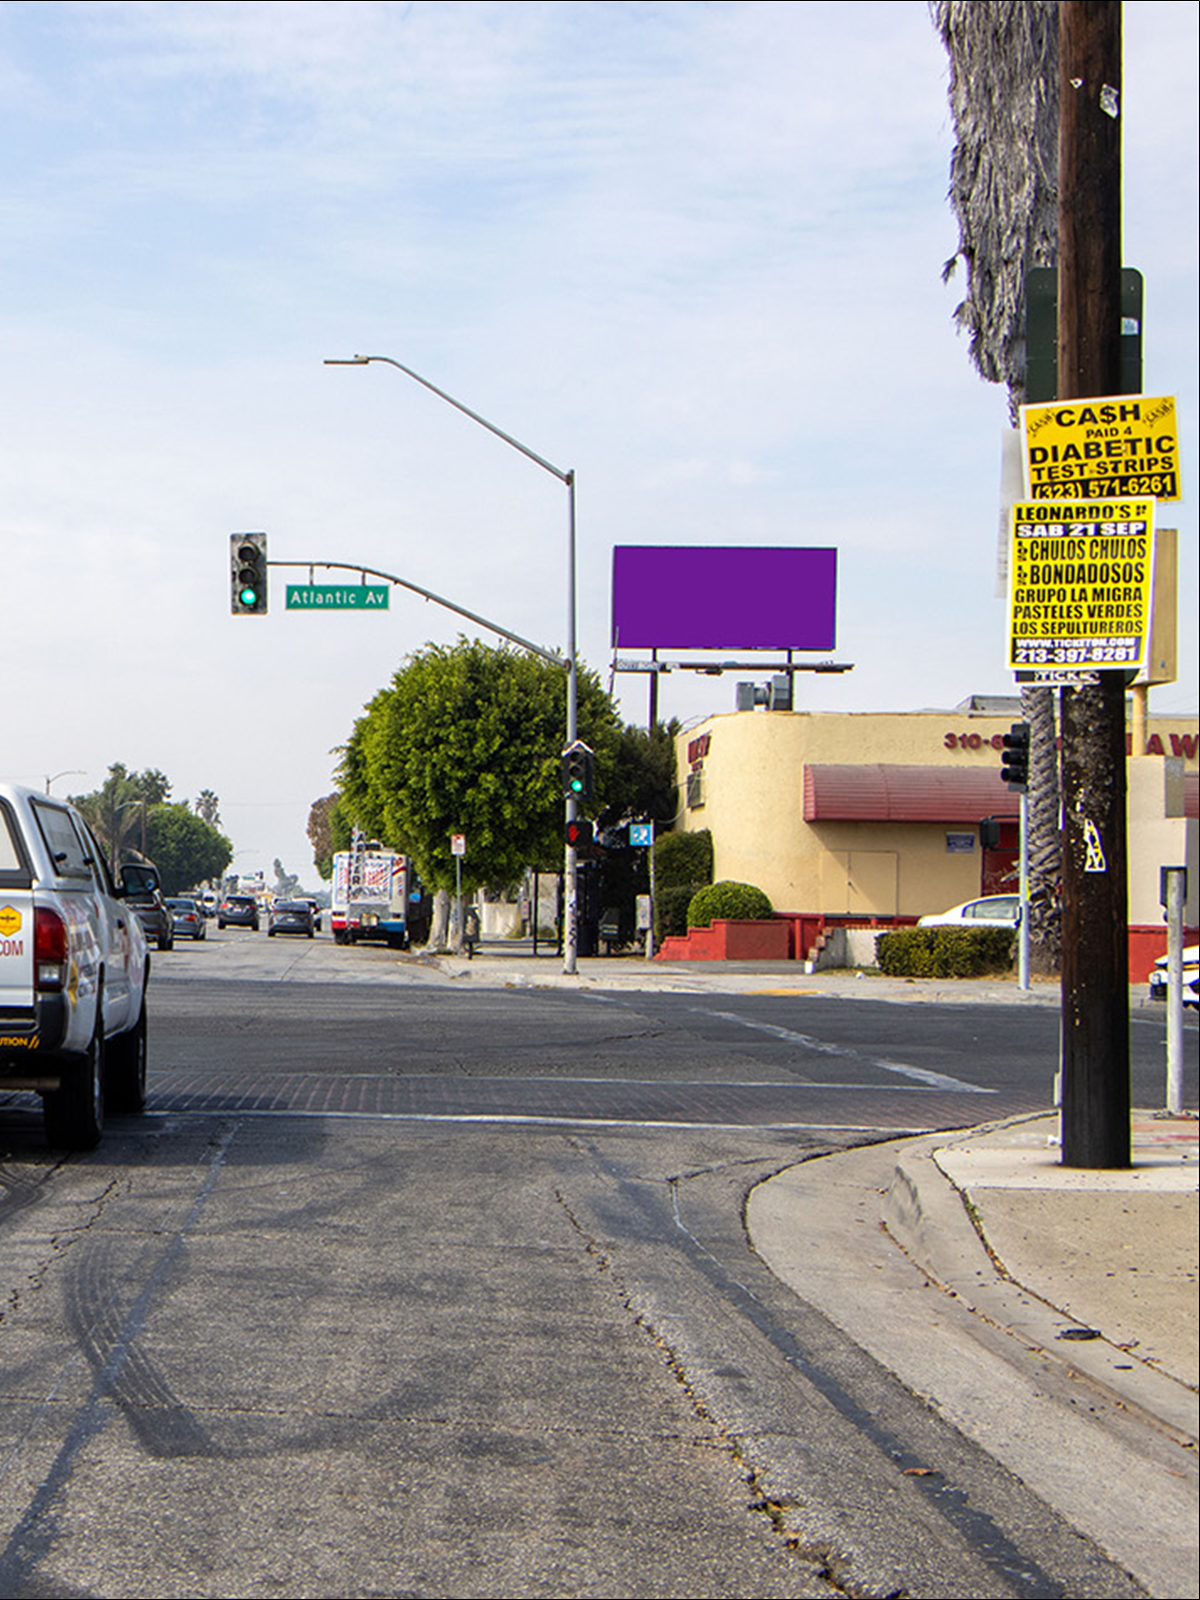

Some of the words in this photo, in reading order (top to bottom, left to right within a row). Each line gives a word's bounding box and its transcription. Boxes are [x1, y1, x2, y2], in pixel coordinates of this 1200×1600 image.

[1055, 404, 1141, 427] CA$H
[1086, 427, 1119, 439] PAID
[1123, 426, 1133, 436] 4
[1029, 435, 1175, 465] DIABETIC
[1032, 462, 1088, 481] TEST
[1096, 456, 1174, 475] STRIPS
[1035, 482, 1083, 499] (323)
[1089, 475, 1172, 497] 571-6261
[1016, 504, 1131, 520] LEONARDO'S
[1017, 524, 1065, 537] SAB
[1069, 523, 1098, 536] 21
[1100, 522, 1145, 536] SEP
[1030, 539, 1086, 561] CHULOS
[1090, 538, 1146, 560] CHULOS
[1030, 562, 1144, 585] BONDADOSOS
[290, 591, 356, 604] Atlantic
[365, 591, 385, 604] Av
[1015, 588, 1067, 603] GRUPO
[1071, 588, 1088, 602] LA
[1092, 587, 1143, 602] MIGRA
[1014, 605, 1083, 619] PASTELES
[1087, 603, 1143, 618] VERDES
[1013, 622, 1037, 635] LOS
[1041, 620, 1143, 635] SEPULTUREROS
[1015, 647, 1137, 662] 213-397-8281
